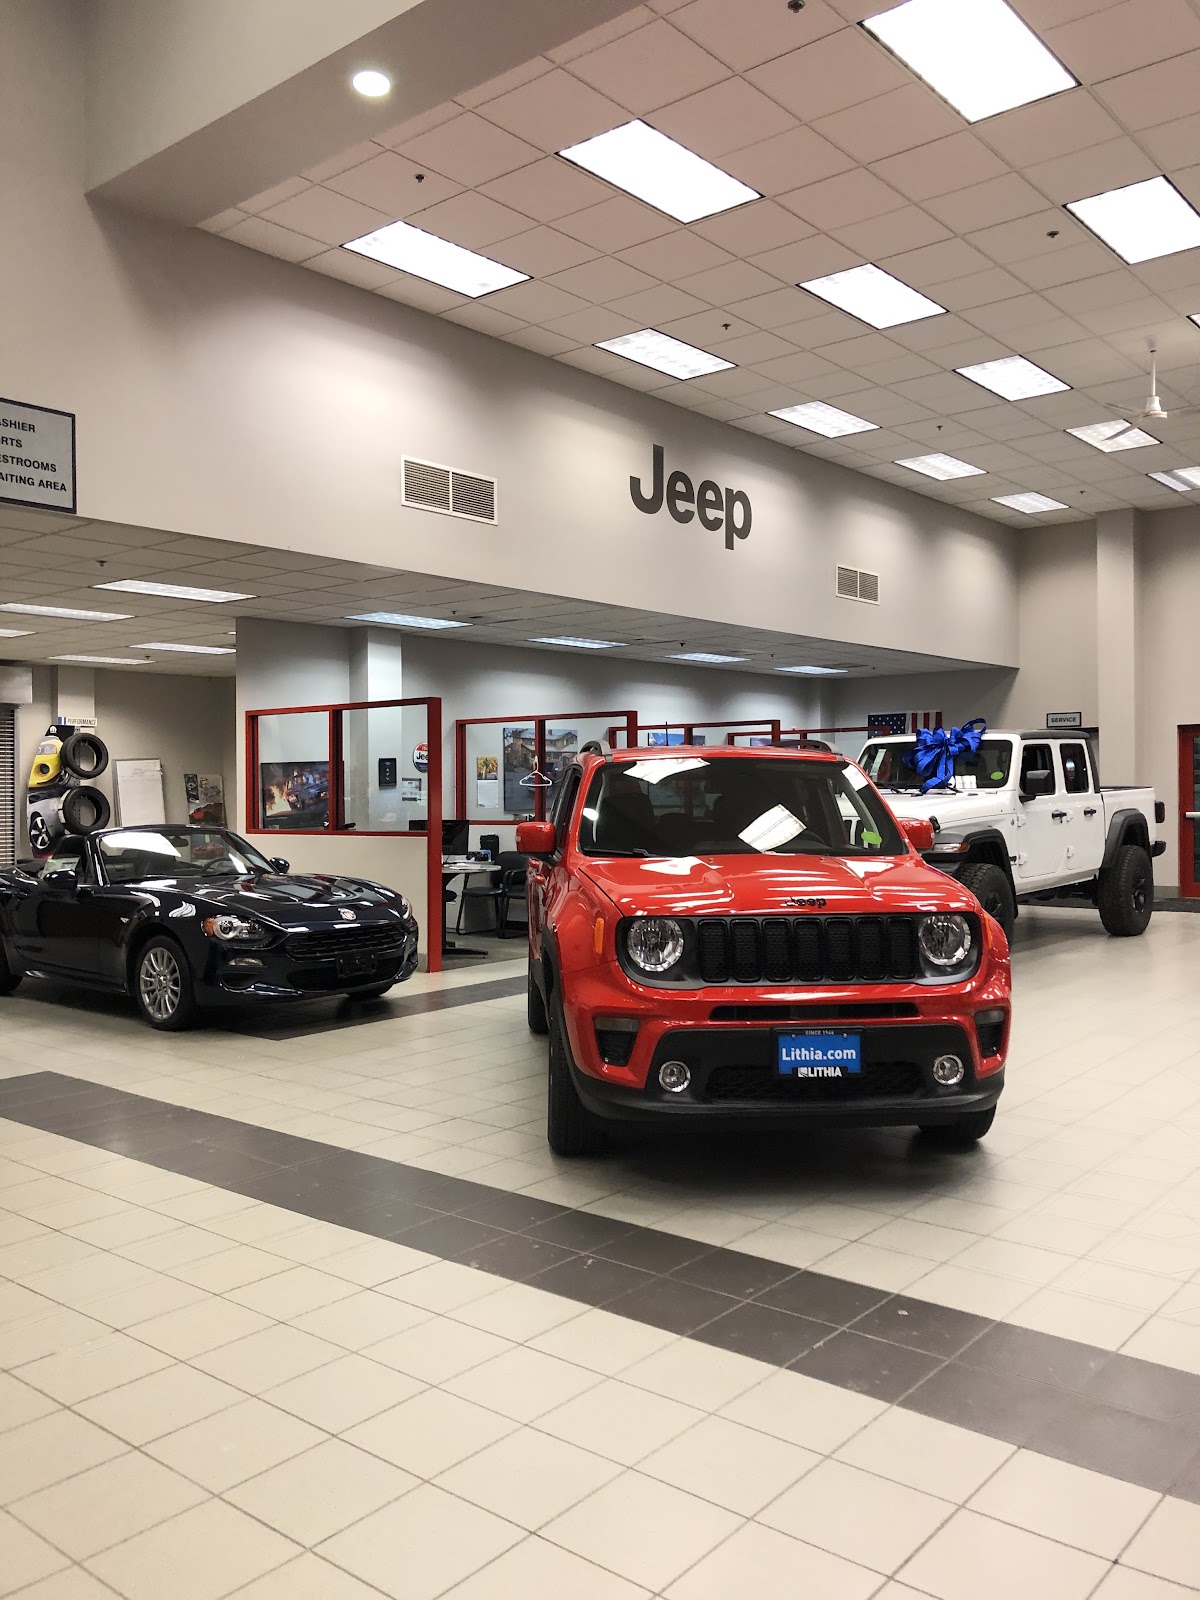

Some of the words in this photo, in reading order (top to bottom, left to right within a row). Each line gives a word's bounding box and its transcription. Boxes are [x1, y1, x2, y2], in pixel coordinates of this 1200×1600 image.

[0, 418, 36, 433] SHIER
[0, 435, 23, 448] RTS
[0, 454, 57, 473] STROOMS
[38, 479, 67, 492] AREA
[630, 443, 752, 551] Jeep
[67, 718, 97, 726] PERFORMANCE
[784, 896, 827, 909] Jeep
[782, 1047, 857, 1061] Lithia.com
[808, 1066, 843, 1078] LITHIA
